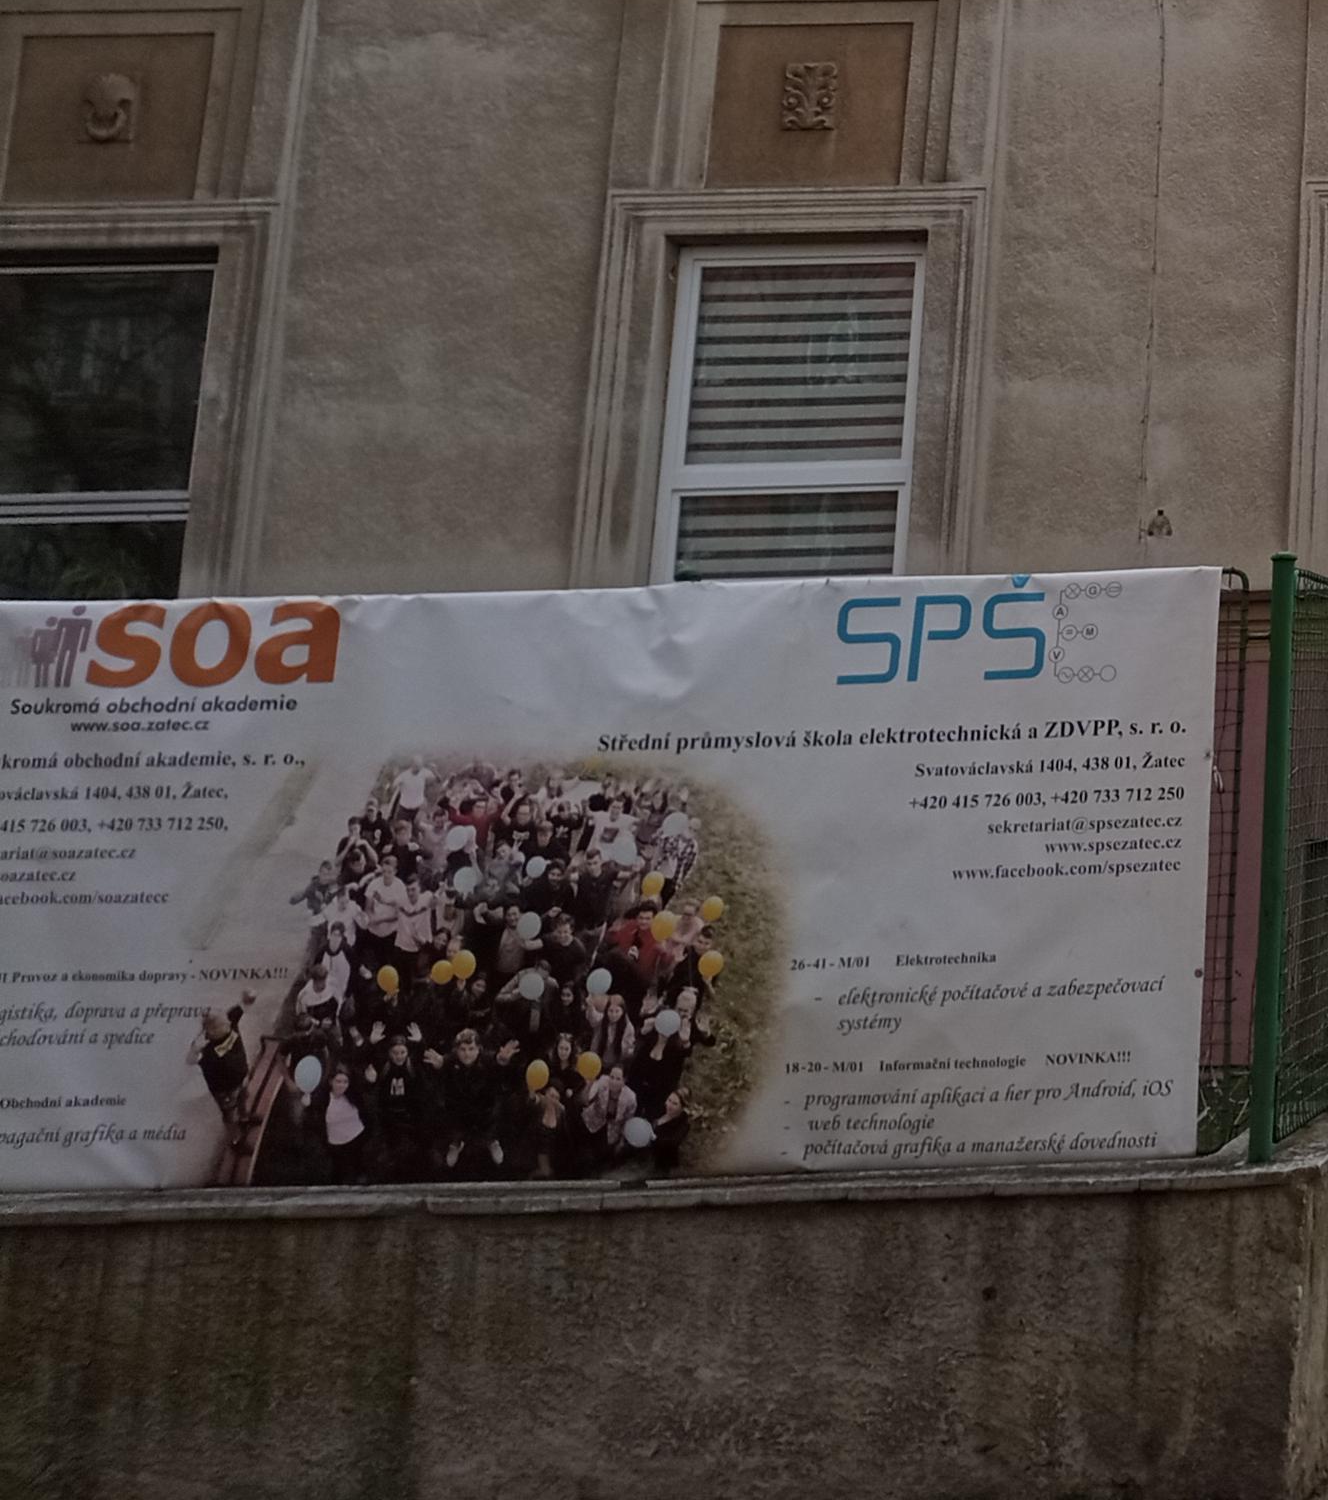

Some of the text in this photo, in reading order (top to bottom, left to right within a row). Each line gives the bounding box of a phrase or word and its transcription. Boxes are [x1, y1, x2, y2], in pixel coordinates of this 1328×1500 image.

[836, 573, 1046, 685] SPŠ
[85, 601, 341, 688] soa
[10, 695, 297, 715] Soukromá obchodní akademie
[70, 718, 209, 733] www.soa.zatec.cz
[599, 719, 1186, 754] Střední průmyslová škola elektrotechnická a ZDVPP, s. r. o.
[64, 750, 140, 768] obchodní
[146, 750, 236, 768] akademie,
[242, 754, 256, 766] s.
[264, 754, 276, 766] r.
[915, 751, 1185, 778] Svatováclavská 1404, 438 01, Žatec
[85, 787, 121, 801] 1404,
[125, 786, 150, 799] 438
[181, 781, 228, 800] Žatec,
[909, 786, 1184, 809] +420 415 726 003, +420 733 712 250
[30, 818, 55, 832] 726
[60, 819, 91, 833] 003,
[98, 818, 133, 831] +420
[138, 817, 162, 831] 733
[168, 817, 192, 831] 712
[197, 816, 228, 831] 250,
[987, 815, 1182, 835] sekretariat@spsezatec.cz
[1045, 837, 1182, 855] www.spsezatec.cz
[952, 859, 1181, 880] www.facebook.com/spsezatec
[896, 952, 997, 967] Elektrotechnika
[12, 971, 57, 984] Provoz
[61, 973, 68, 982] a
[72, 969, 134, 982] ekonomika
[139, 969, 188, 985] dopravy
[199, 967, 288, 981] NOVINKA!!!
[838, 984, 937, 1008] elektronické
[940, 981, 1028, 1007] počítačové
[1032, 986, 1041, 997] a
[1047, 975, 1165, 1000] zabezpečovací
[64, 1001, 125, 1022] doprava
[130, 1007, 140, 1019] a
[837, 1013, 902, 1036] systémy
[89, 1033, 98, 1044] a
[102, 1028, 155, 1049] spedice
[880, 1058, 950, 1072] Informační
[954, 1054, 1026, 1071] technologie
[1046, 1050, 1131, 1067] NOVINKA!!!
[64, 1094, 127, 1108] akademie
[804, 1088, 918, 1111] programování
[989, 1090, 999, 1102] a
[1005, 1083, 1031, 1102] her
[1034, 1088, 1061, 1106] pro
[1063, 1079, 1136, 1101] Android,
[1142, 1079, 1174, 1098] iOS
[62, 1123, 124, 1146] grafika
[128, 1129, 137, 1141] a
[142, 1122, 187, 1141] média
[808, 1114, 840, 1131] web
[846, 1112, 935, 1135] technologie
[803, 1138, 888, 1161] počítačová
[892, 1136, 951, 1160] grafika
[956, 1144, 965, 1154] a
[971, 1132, 1065, 1155] manažerské
[1069, 1130, 1158, 1151] dovednosti
